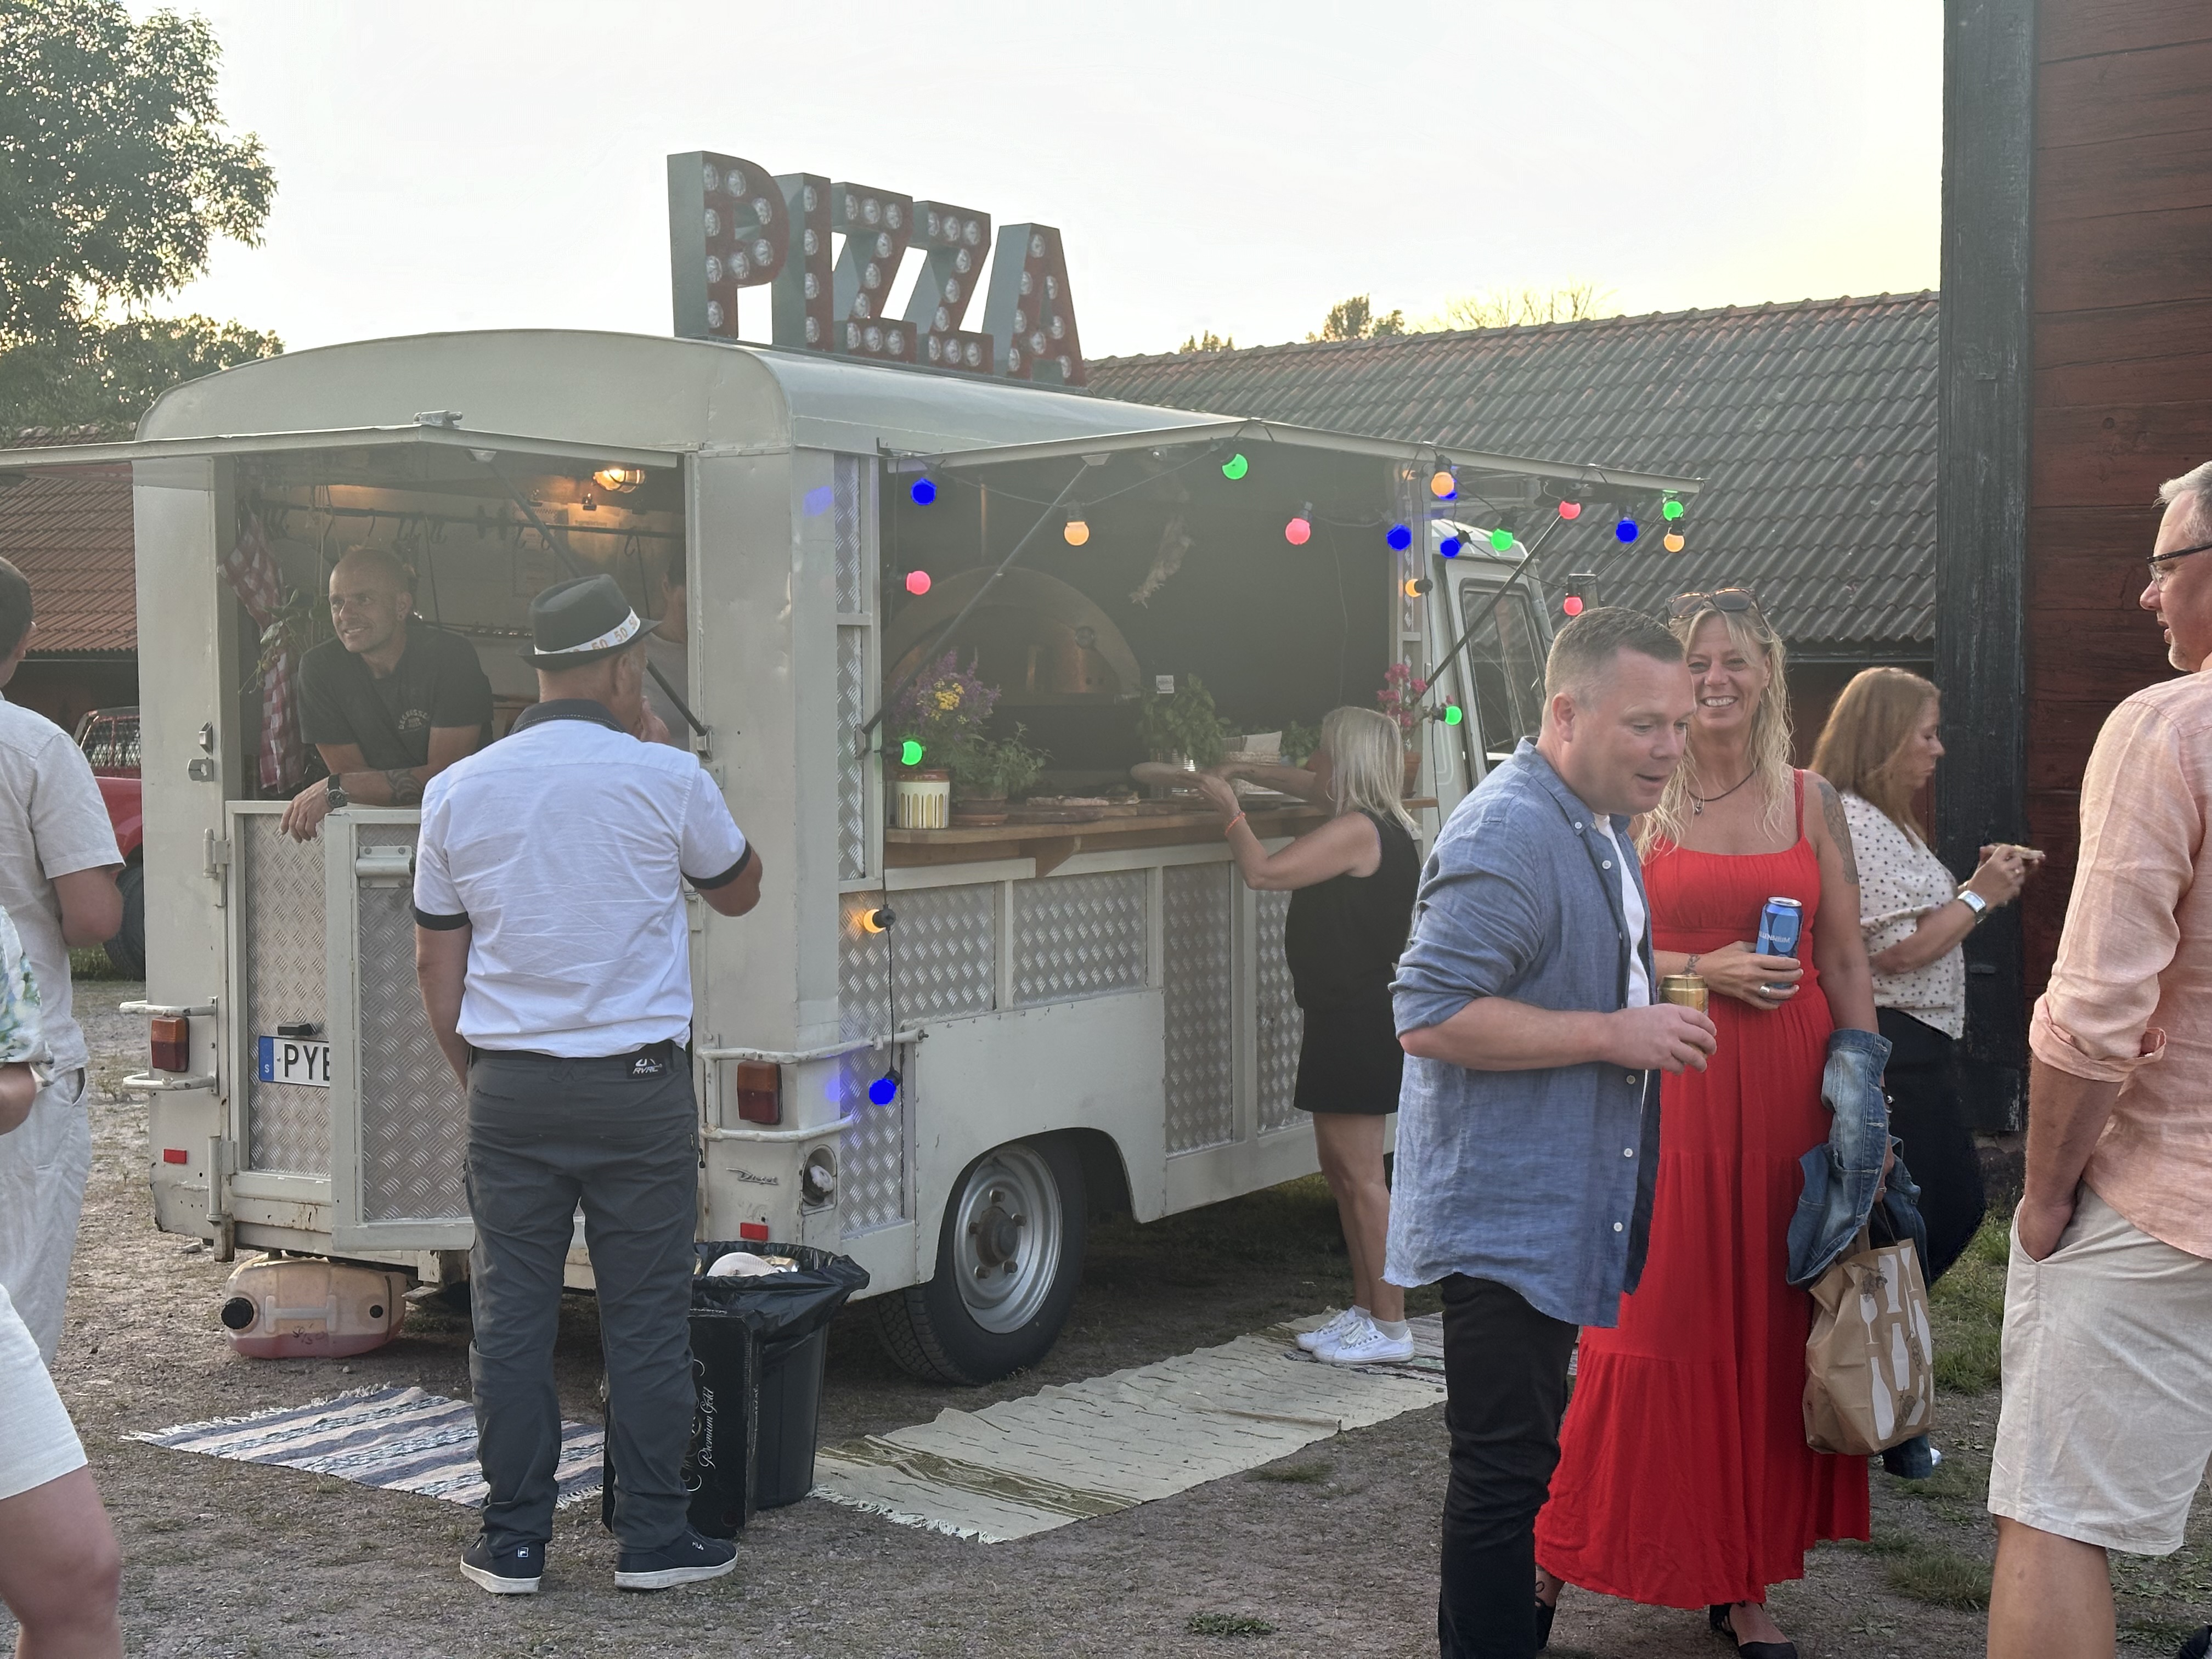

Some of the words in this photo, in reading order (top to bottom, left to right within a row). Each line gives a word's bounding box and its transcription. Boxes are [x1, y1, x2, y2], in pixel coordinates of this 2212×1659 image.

[667, 151, 1085, 387] PIZZA
[264, 1064, 270, 1073] S
[699, 1386, 718, 1414] Gold
[697, 1415, 716, 1469] Premium
